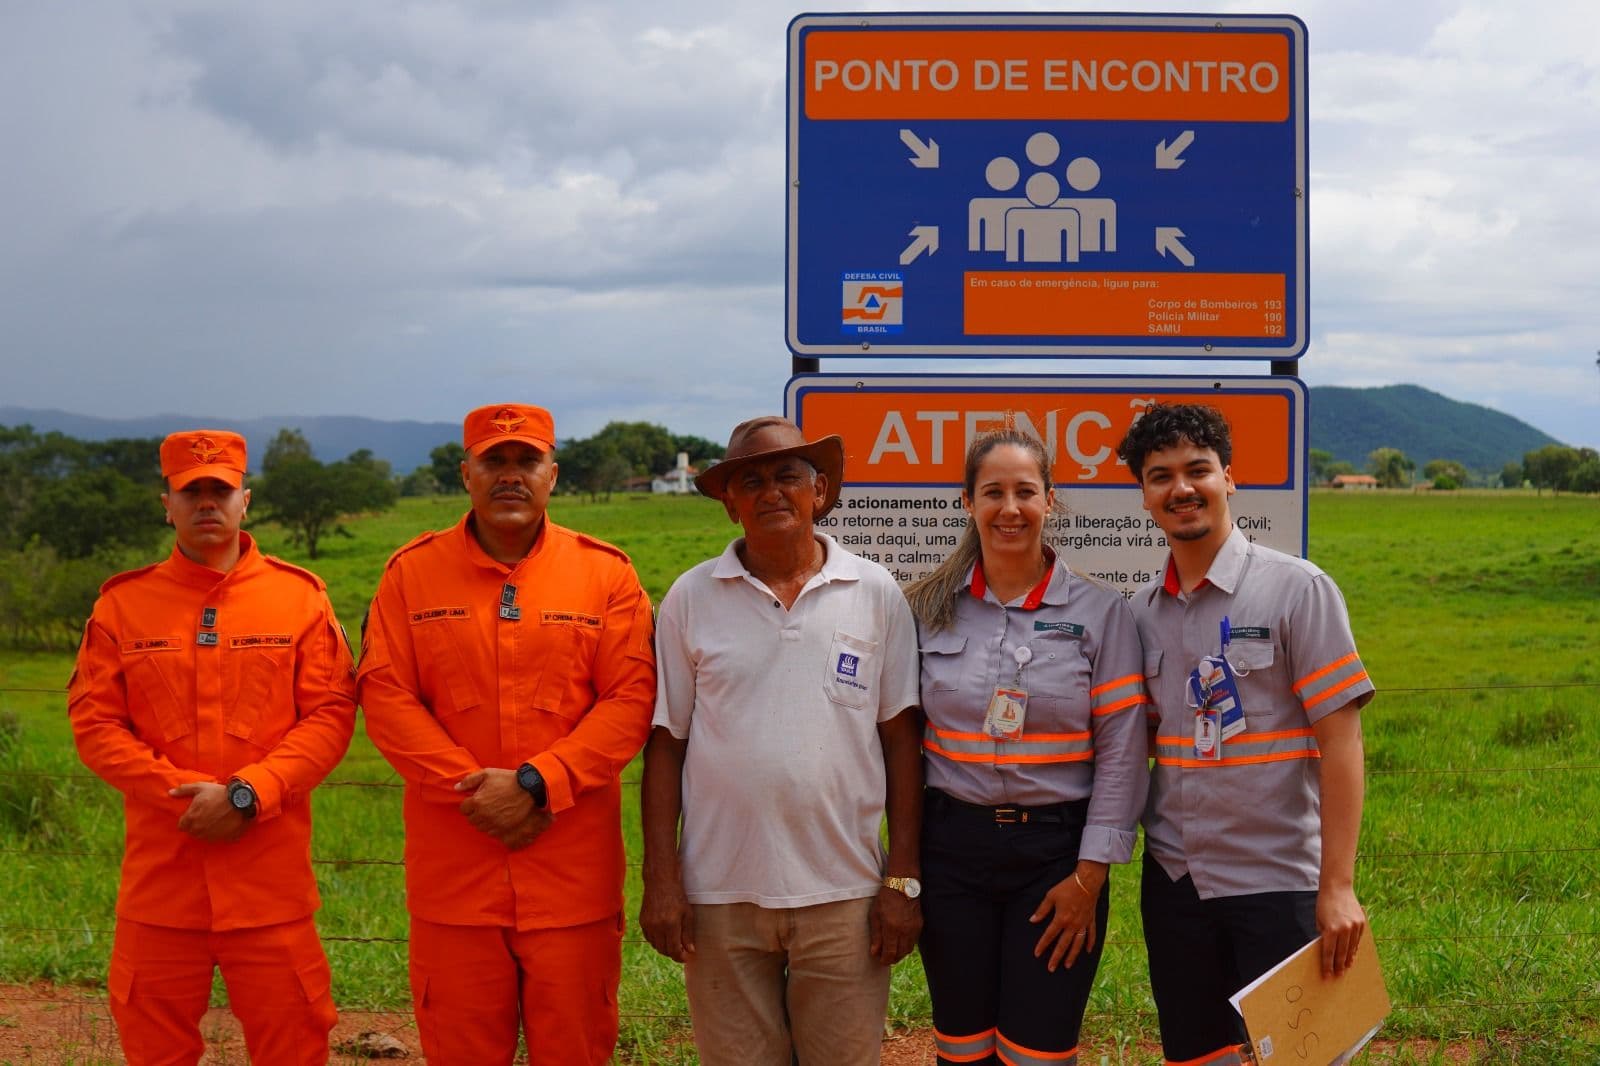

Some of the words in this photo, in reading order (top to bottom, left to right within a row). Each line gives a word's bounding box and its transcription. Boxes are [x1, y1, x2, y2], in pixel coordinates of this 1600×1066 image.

[814, 59, 960, 92] PONTO
[973, 59, 1029, 92] DE
[1044, 60, 1279, 94] ENCONTRO
[970, 277, 988, 288] Em
[990, 279, 1017, 288] caso
[1019, 277, 1032, 288] de
[1103, 278, 1130, 290] ligue
[1132, 280, 1160, 290] para:
[1147, 299, 1181, 310] Corpo
[1184, 299, 1197, 309] de
[1200, 299, 1258, 310] Bombeiros
[1264, 300, 1282, 310] 193
[1187, 311, 1220, 321] Militar
[1264, 312, 1282, 322] 190
[1147, 323, 1181, 333] SAMU
[1264, 325, 1282, 335] 192
[848, 496, 948, 510] acionamento
[843, 515, 893, 527] retorne
[898, 517, 907, 527] a
[912, 517, 938, 527] sua
[1075, 515, 1142, 532] liberação
[1237, 516, 1271, 531] Civil;
[843, 532, 872, 545] saia
[876, 532, 920, 548] daqui,
[925, 535, 957, 546] uma
[1127, 534, 1152, 547] virá
[885, 553, 893, 563] a
[1132, 570, 1150, 582] da
